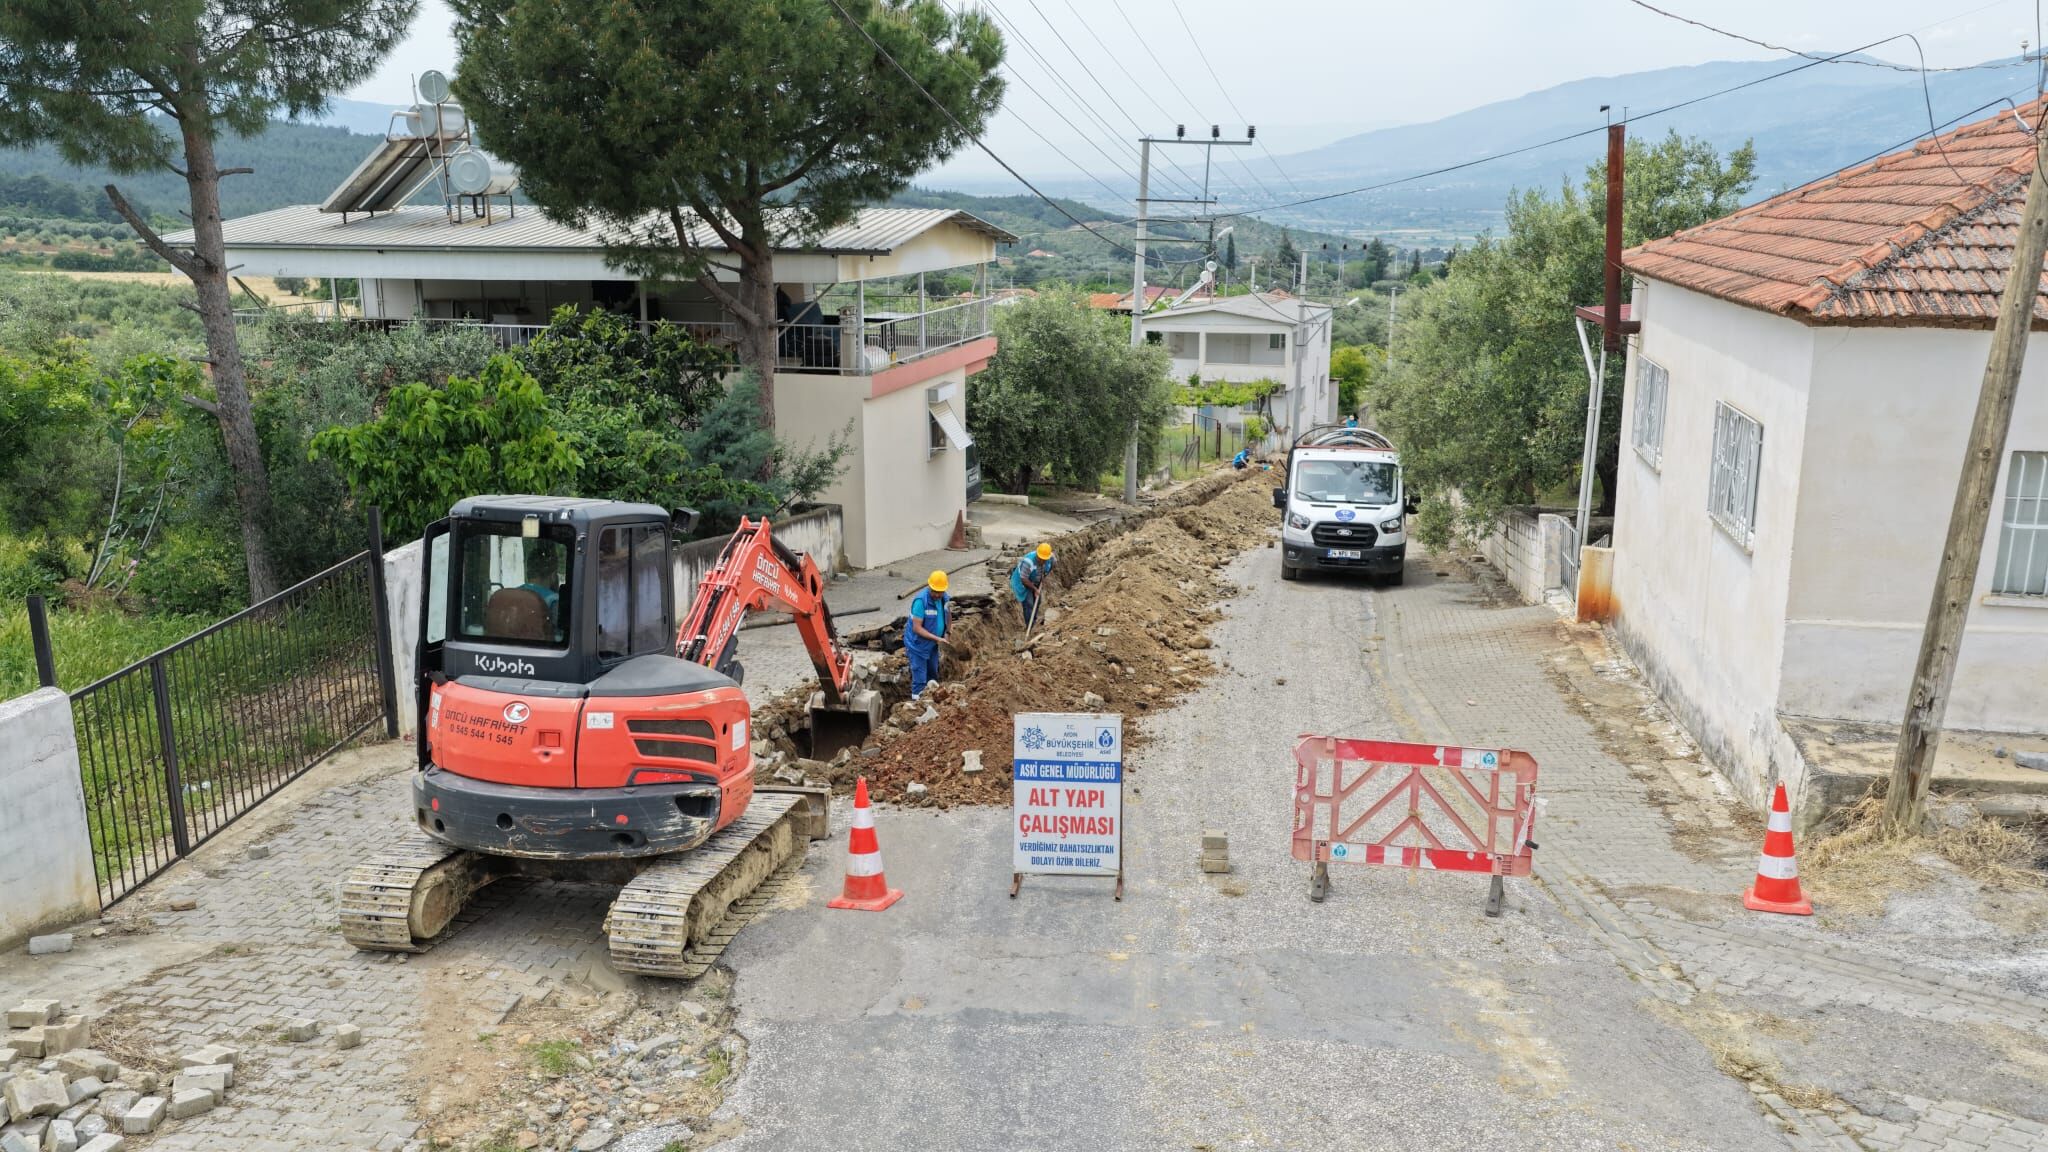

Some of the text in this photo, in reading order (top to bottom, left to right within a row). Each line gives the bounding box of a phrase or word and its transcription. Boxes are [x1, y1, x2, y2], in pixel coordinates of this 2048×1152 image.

[475, 654, 535, 675] Kubota
[456, 725, 468, 736] 545
[471, 729, 485, 739] 544
[496, 734, 513, 745] 545
[1046, 738, 1094, 750] BÜYÜKŞEHİR
[1020, 761, 1116, 780] ASKİ GENEL MÜDÜRLÜĞÜ
[1028, 788, 1105, 809] ALT YAPI
[1019, 814, 1114, 839] ÇALIŞMASI
[1019, 841, 1114, 854] VERDİĞİMİZ RAHATSIZLIKTAN
[1031, 856, 1055, 866] DOLAYI
[1056, 856, 1073, 866] ÖZÜR
